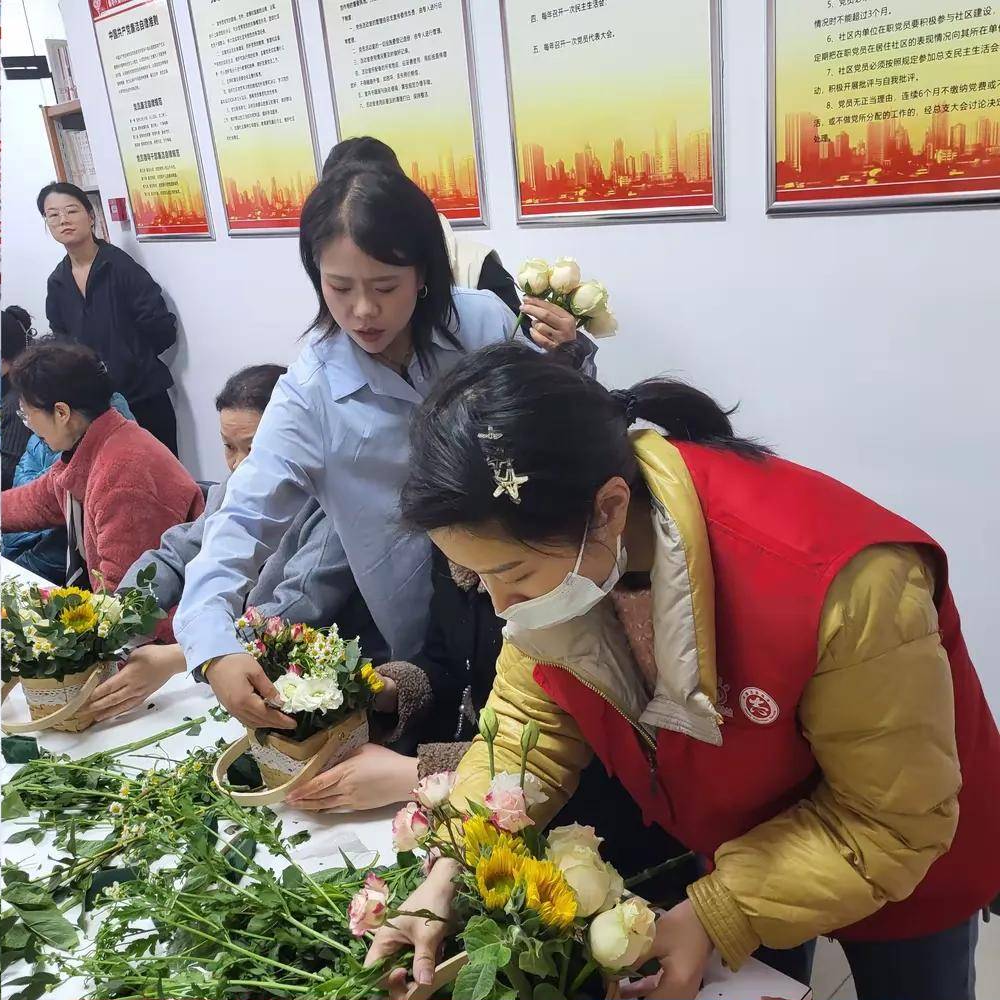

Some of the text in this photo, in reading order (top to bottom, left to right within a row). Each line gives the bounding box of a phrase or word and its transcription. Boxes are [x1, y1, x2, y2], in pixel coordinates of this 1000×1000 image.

[533, 29, 615, 54] 五、每年召开一次党员代表大会。
[813, 73, 919, 96] 动，积极开展批评与自我批评。
